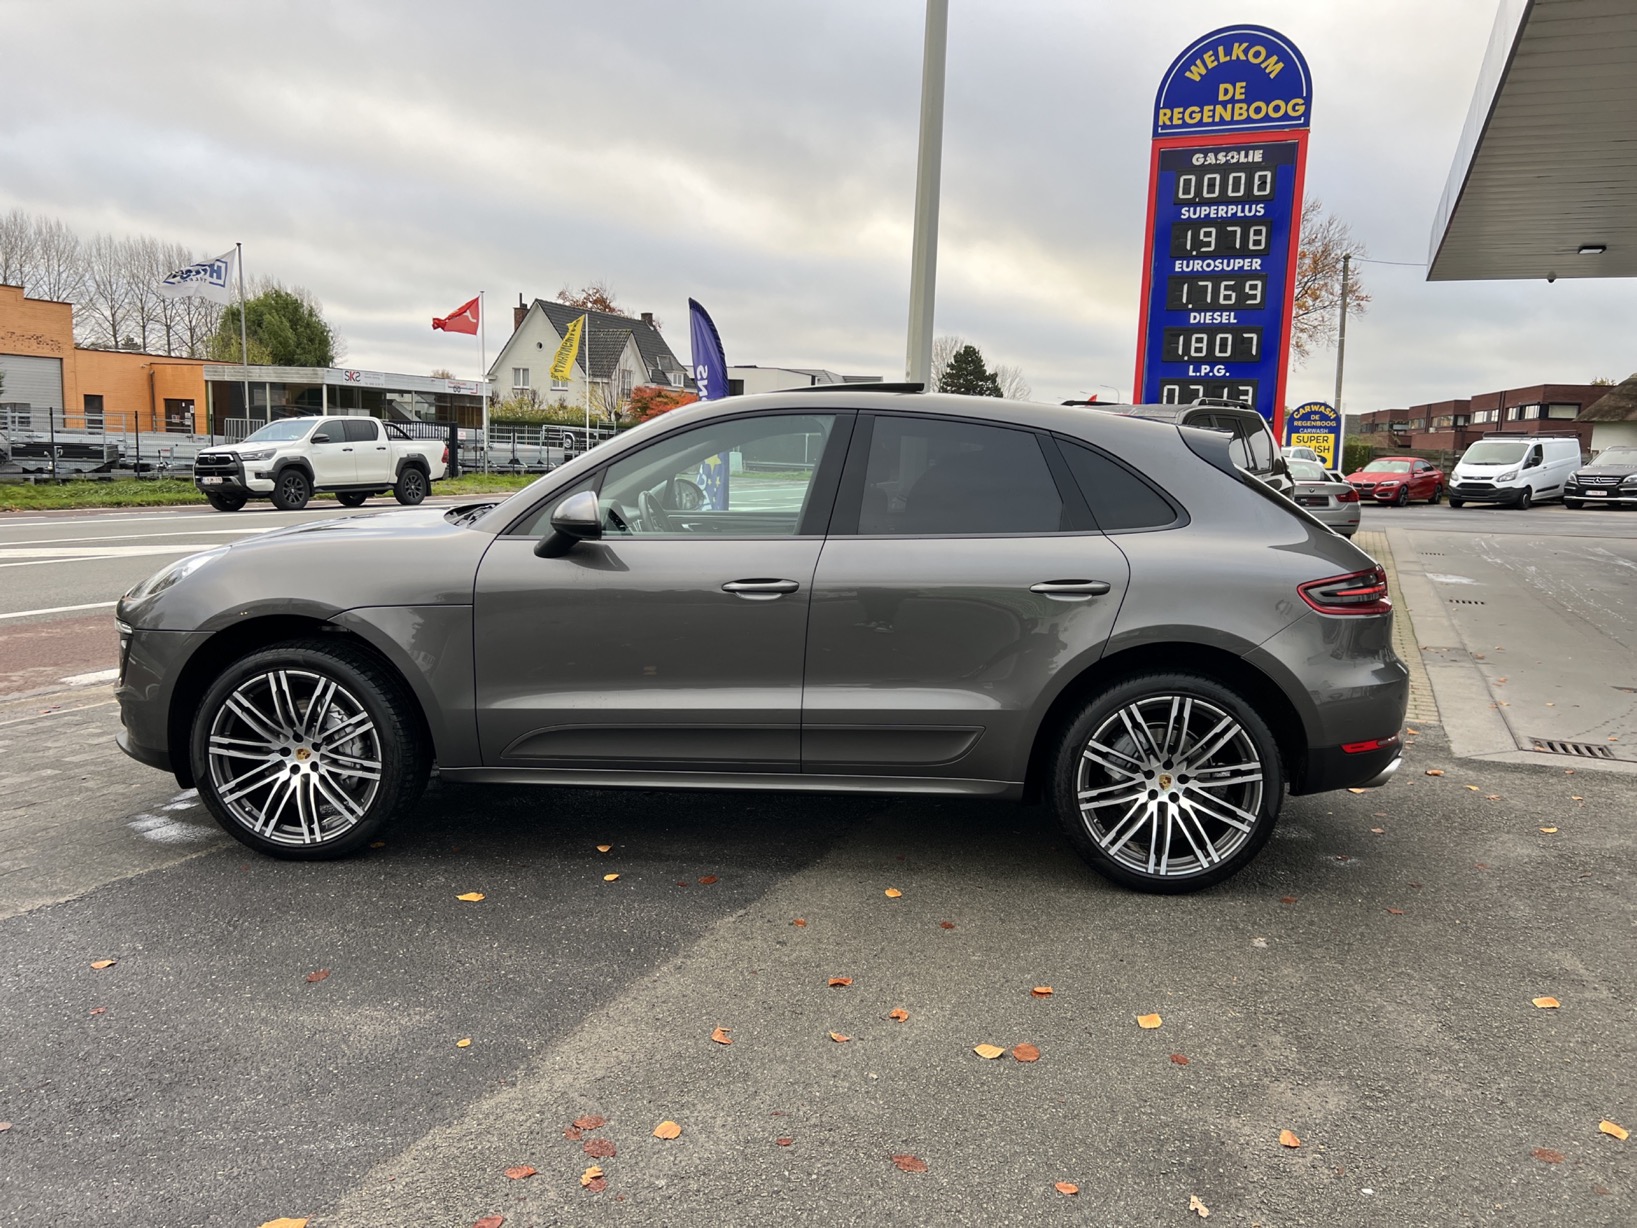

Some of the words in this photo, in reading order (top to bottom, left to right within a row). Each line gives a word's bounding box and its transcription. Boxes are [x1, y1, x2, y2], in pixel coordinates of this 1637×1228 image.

[1184, 42, 1285, 82] WELKOM
[1218, 82, 1247, 101] DE
[1158, 98, 1306, 126] REGENBOOG
[1191, 149, 1264, 166] GASOLIE
[1180, 204, 1265, 219] SUPERPLUS
[1185, 225, 1267, 255] 1.978
[1174, 258, 1262, 273] EUROSUPER
[1181, 279, 1263, 309] 1.769
[1189, 311, 1238, 325] DIESEL
[1177, 333, 1258, 361] 1.807
[1188, 364, 1230, 377] L.P.G.
[1293, 404, 1336, 419] CARWASH
[1296, 435, 1329, 444] SUPER
